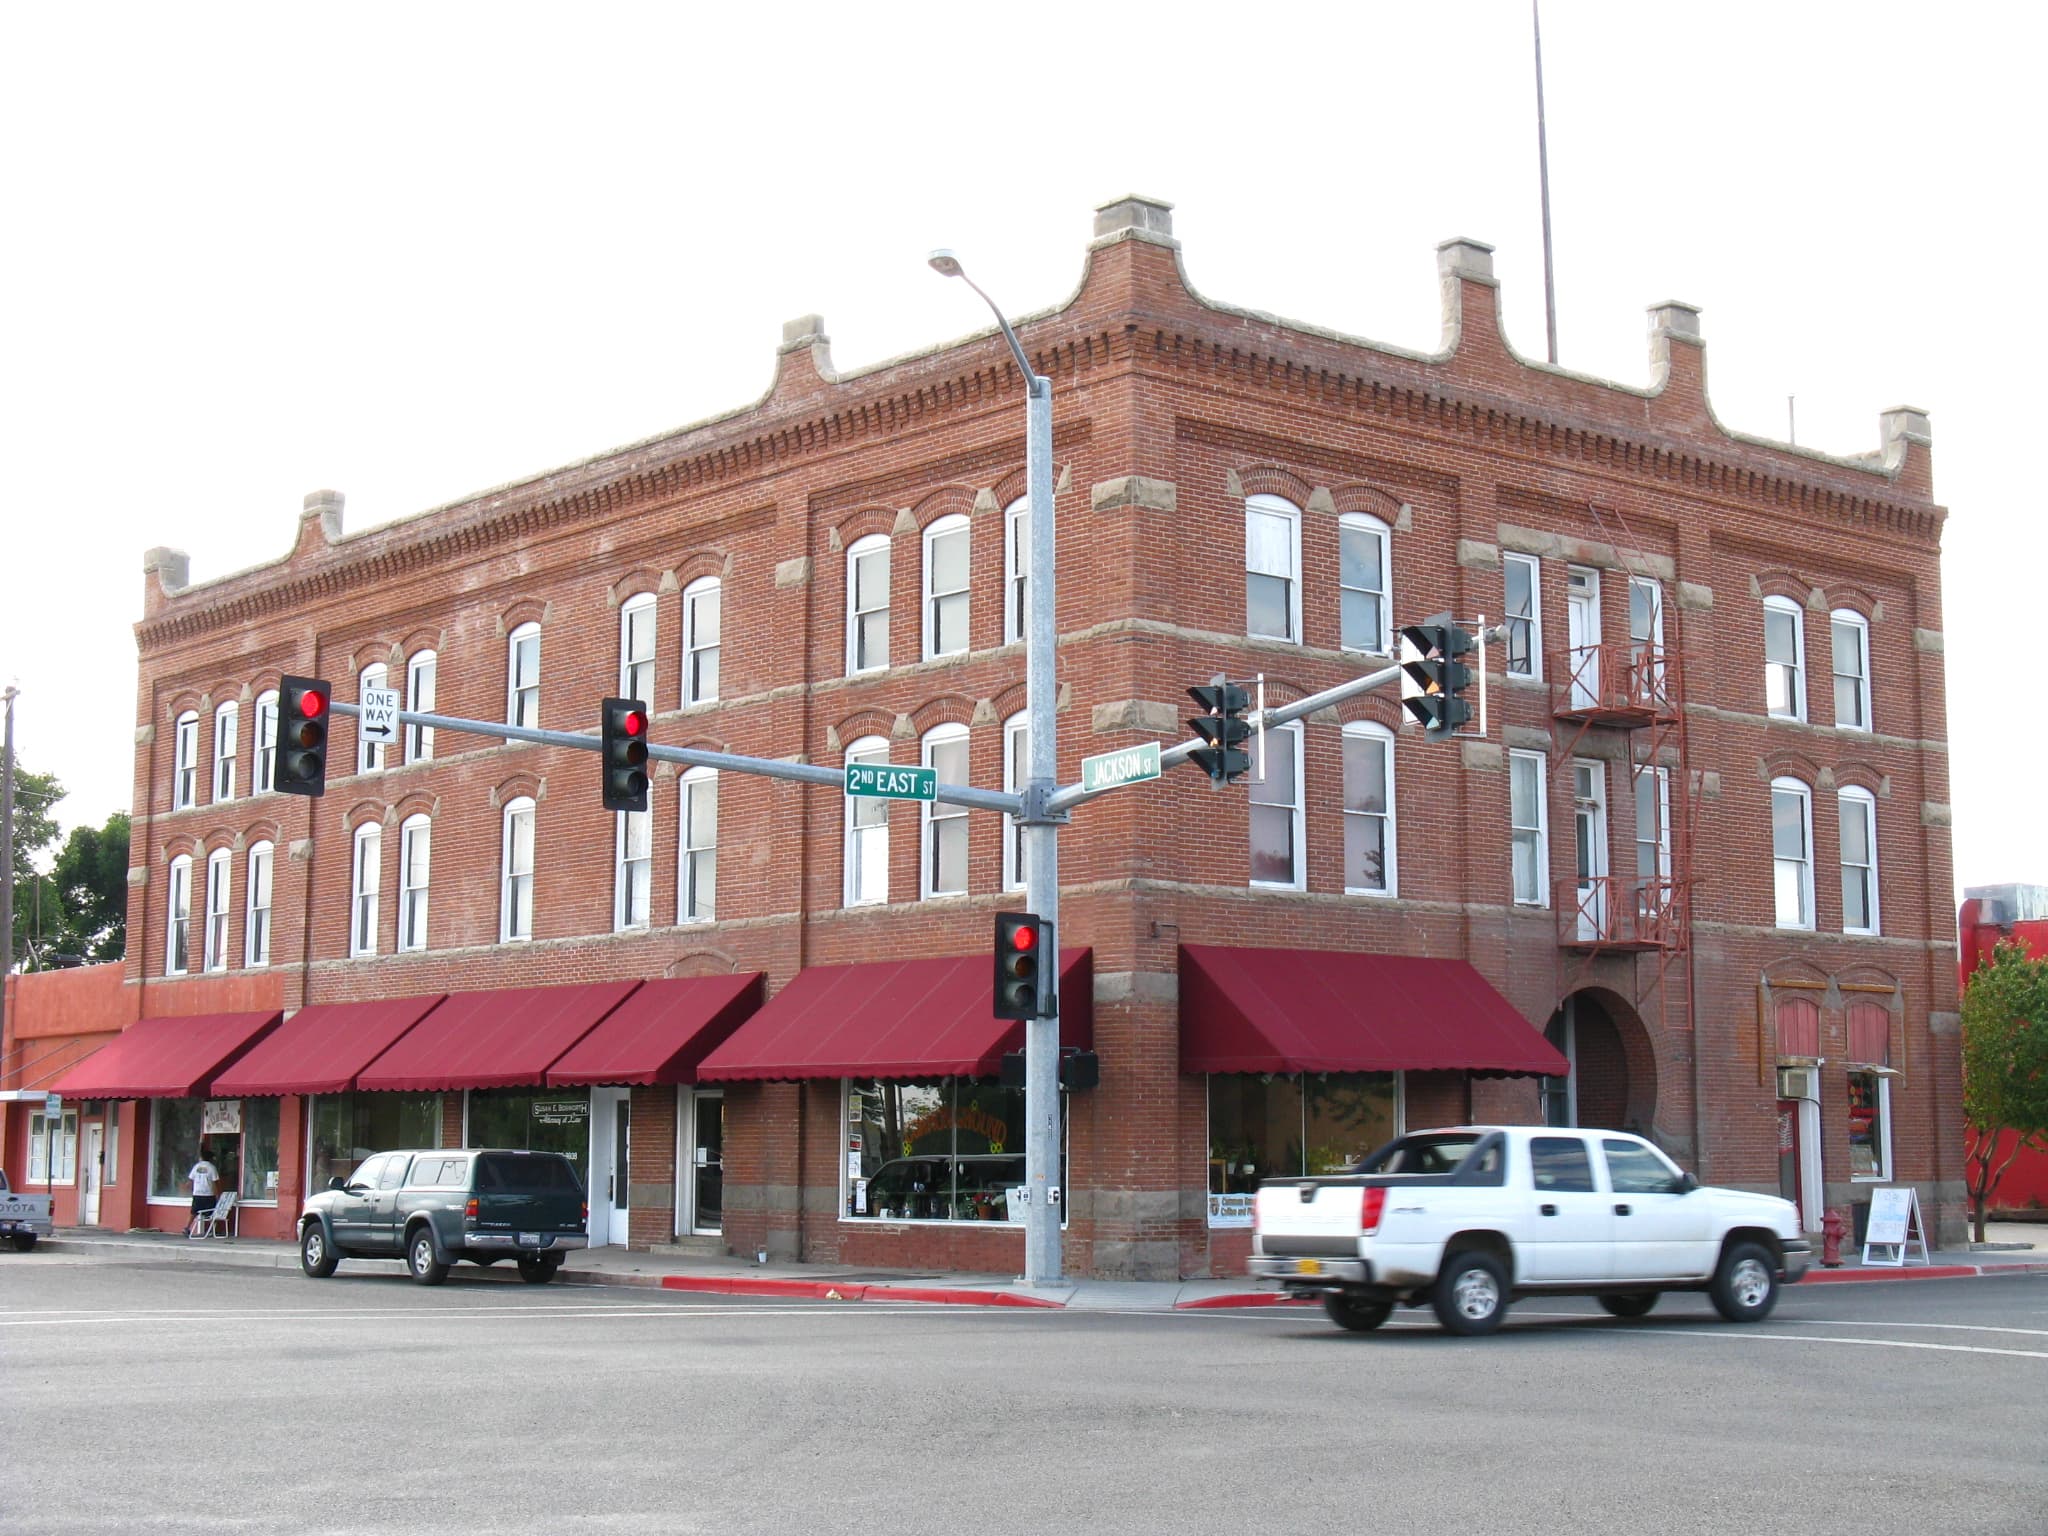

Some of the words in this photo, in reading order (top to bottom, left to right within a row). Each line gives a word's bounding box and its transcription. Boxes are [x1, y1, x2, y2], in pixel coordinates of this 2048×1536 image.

[366, 692, 394, 707] ONE
[365, 708, 393, 722] WAY
[1092, 752, 1141, 786] JACKSON
[1143, 758, 1152, 775] ST
[849, 768, 874, 790] 2ND
[876, 770, 918, 794] EAST
[922, 780, 934, 795] ST
